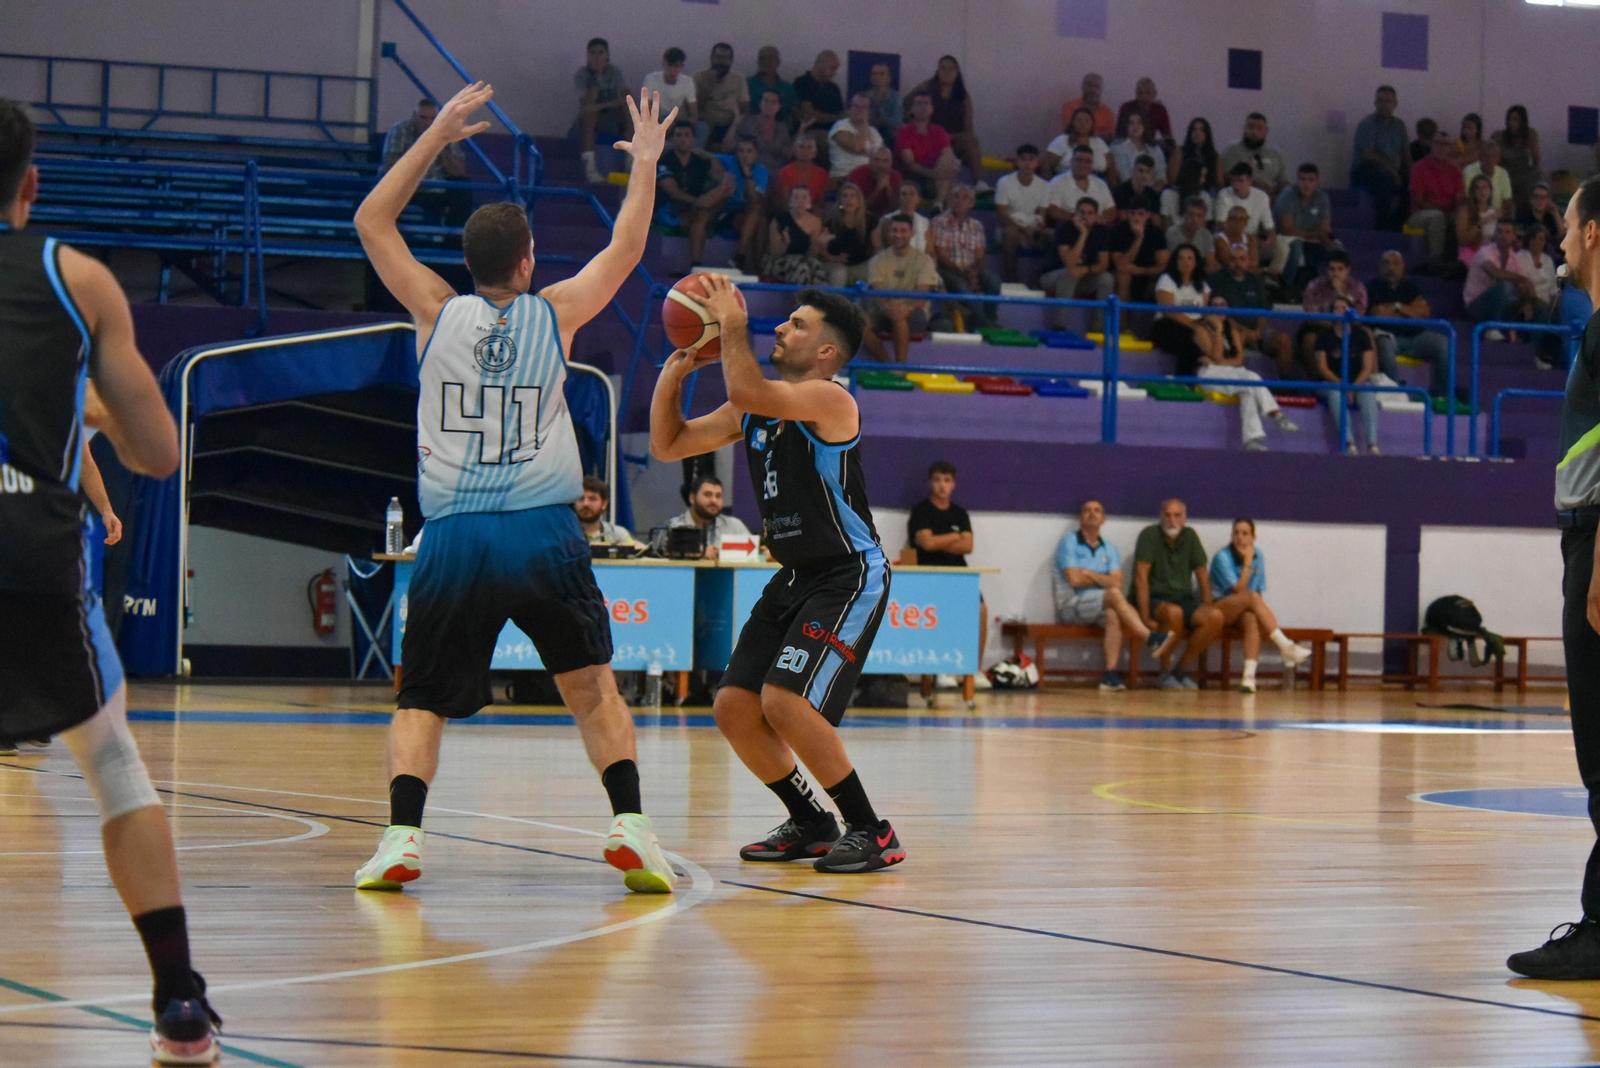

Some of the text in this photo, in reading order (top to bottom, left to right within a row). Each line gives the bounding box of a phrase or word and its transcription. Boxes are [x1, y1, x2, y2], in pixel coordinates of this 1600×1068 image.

[441, 381, 542, 465] 41
[887, 599, 939, 629] tes
[776, 645, 810, 674] 20
